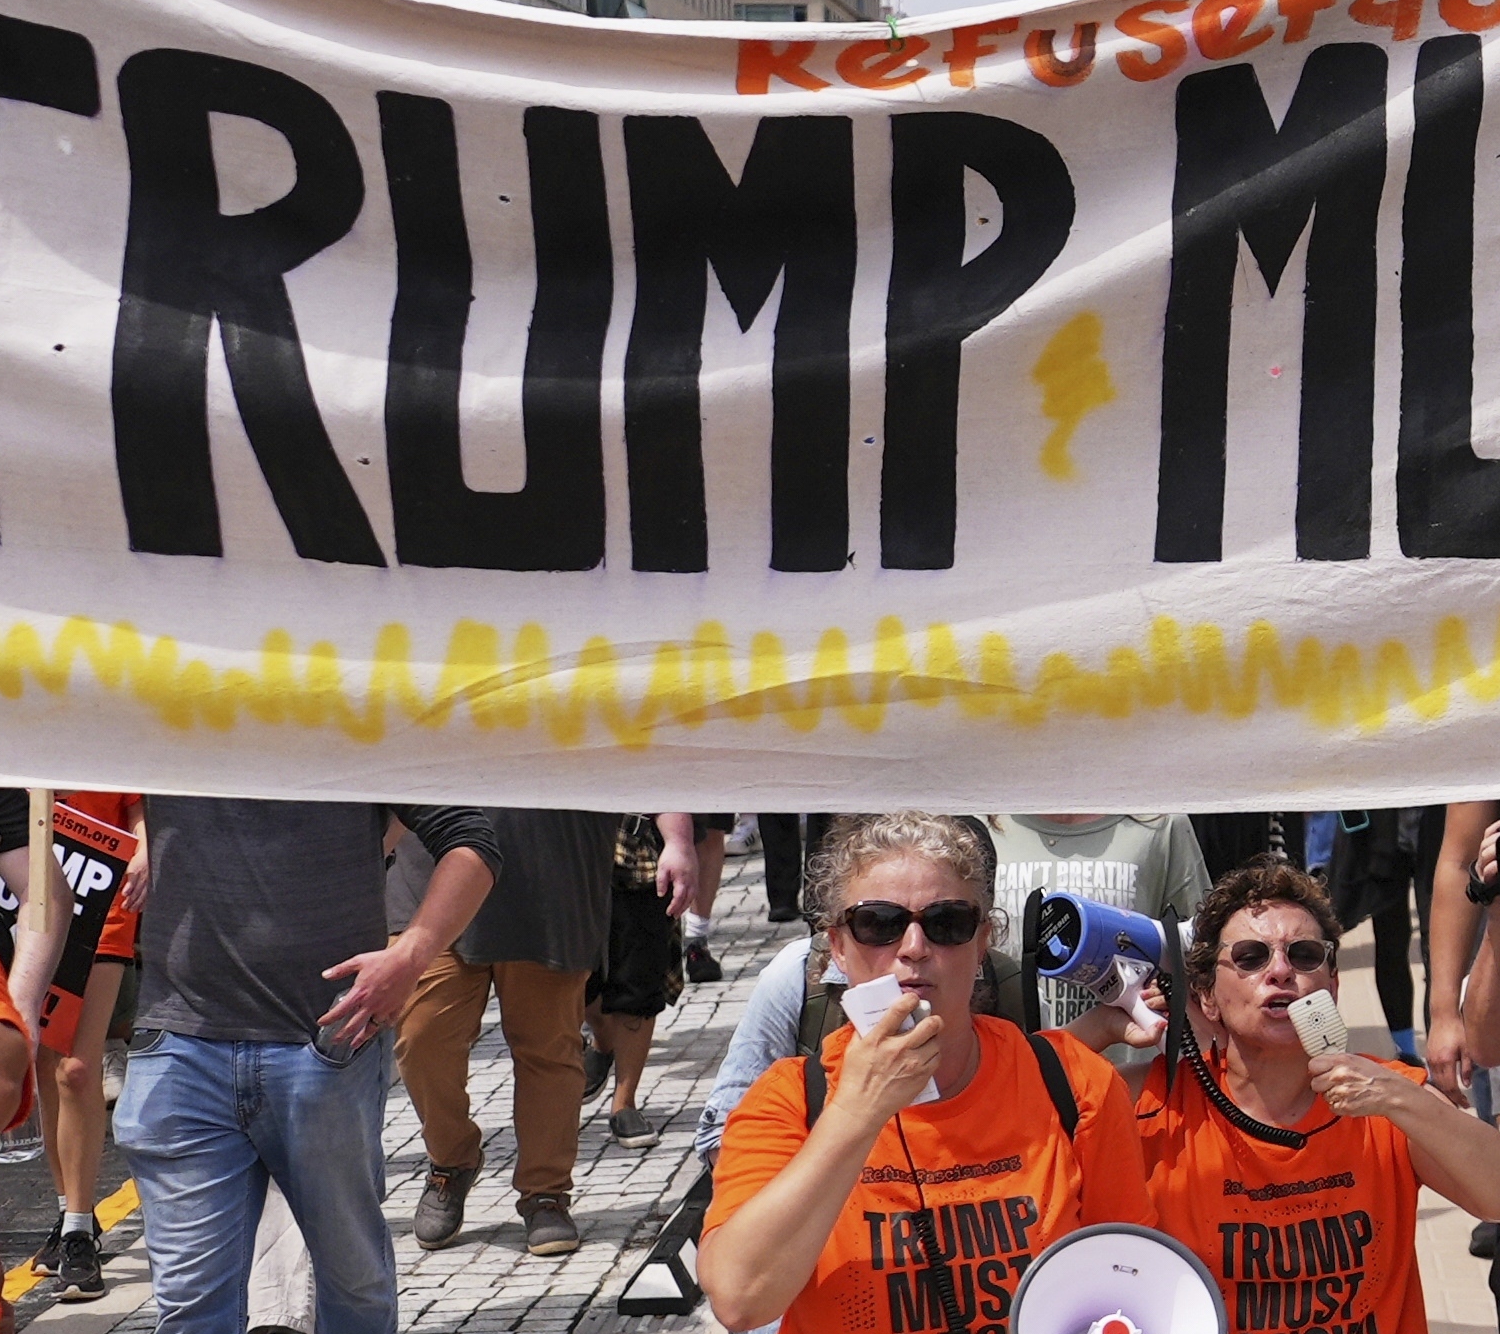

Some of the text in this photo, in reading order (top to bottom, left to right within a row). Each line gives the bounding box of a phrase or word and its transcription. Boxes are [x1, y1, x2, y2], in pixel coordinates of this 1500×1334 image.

[1057, 860, 1139, 892] BREATHE
[1099, 975, 1119, 997] PYLE
[863, 1195, 1039, 1271] TRUMP
[1218, 1210, 1373, 1280] TRUMP
[1235, 1271, 1364, 1330] MUST
